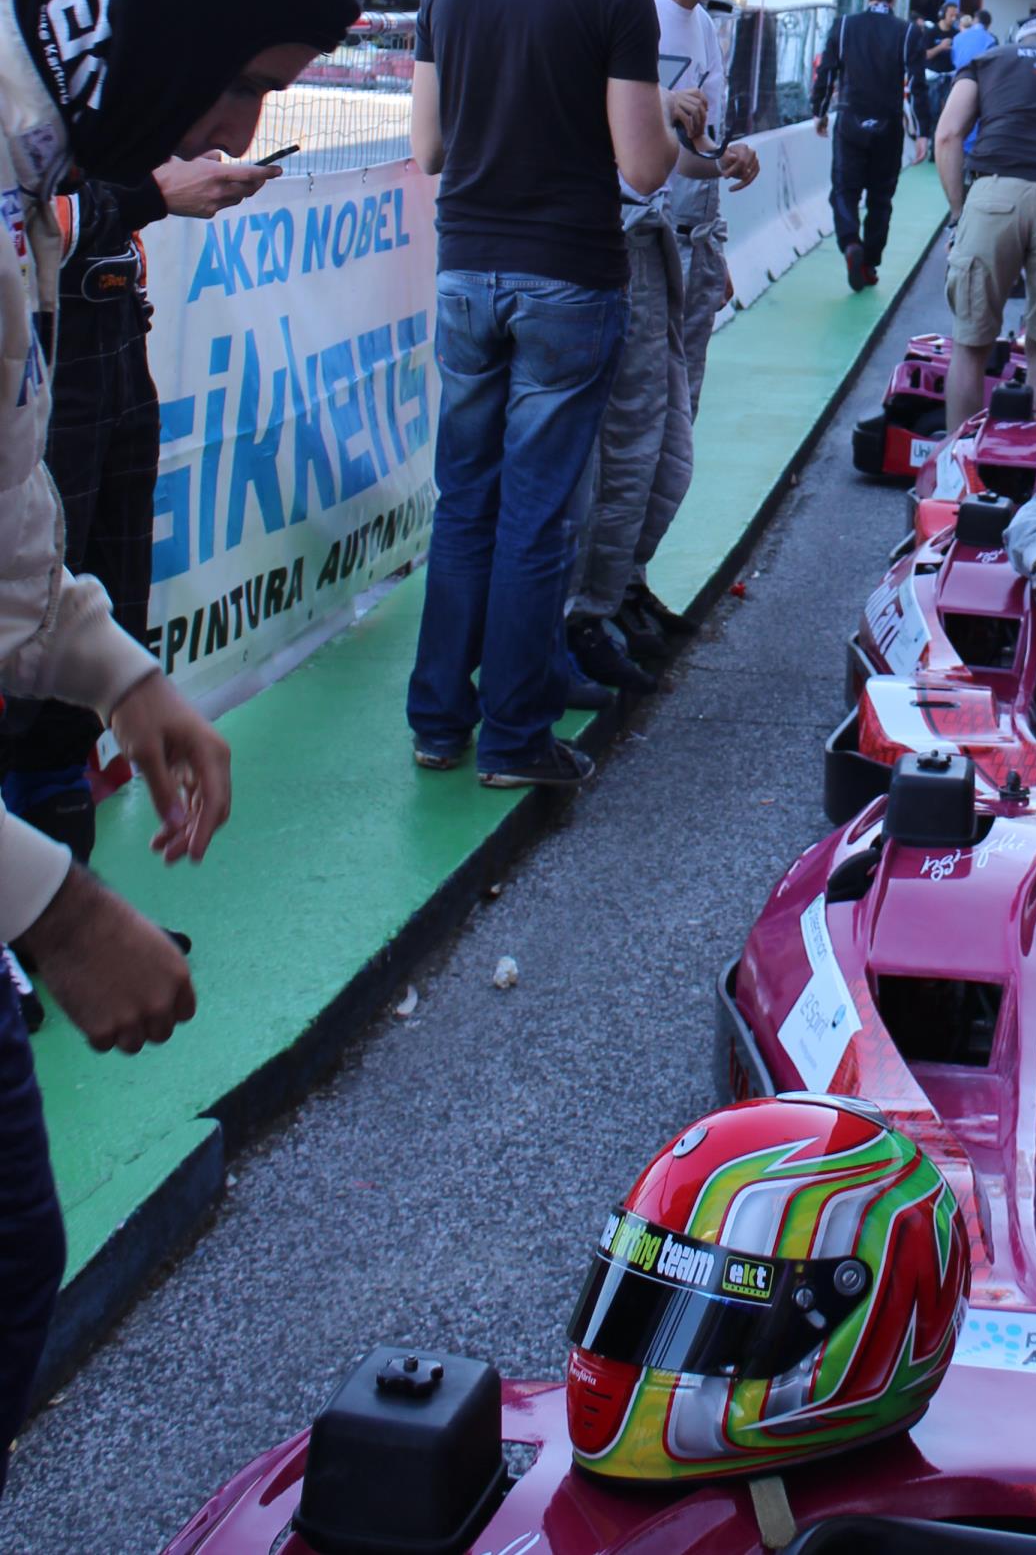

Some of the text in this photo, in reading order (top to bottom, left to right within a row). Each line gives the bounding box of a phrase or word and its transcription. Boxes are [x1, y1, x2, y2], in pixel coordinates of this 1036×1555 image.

[187, 187, 410, 304] AKZO NOBEL
[657, 1233, 715, 1287] team
[729, 1262, 768, 1289] ekt
